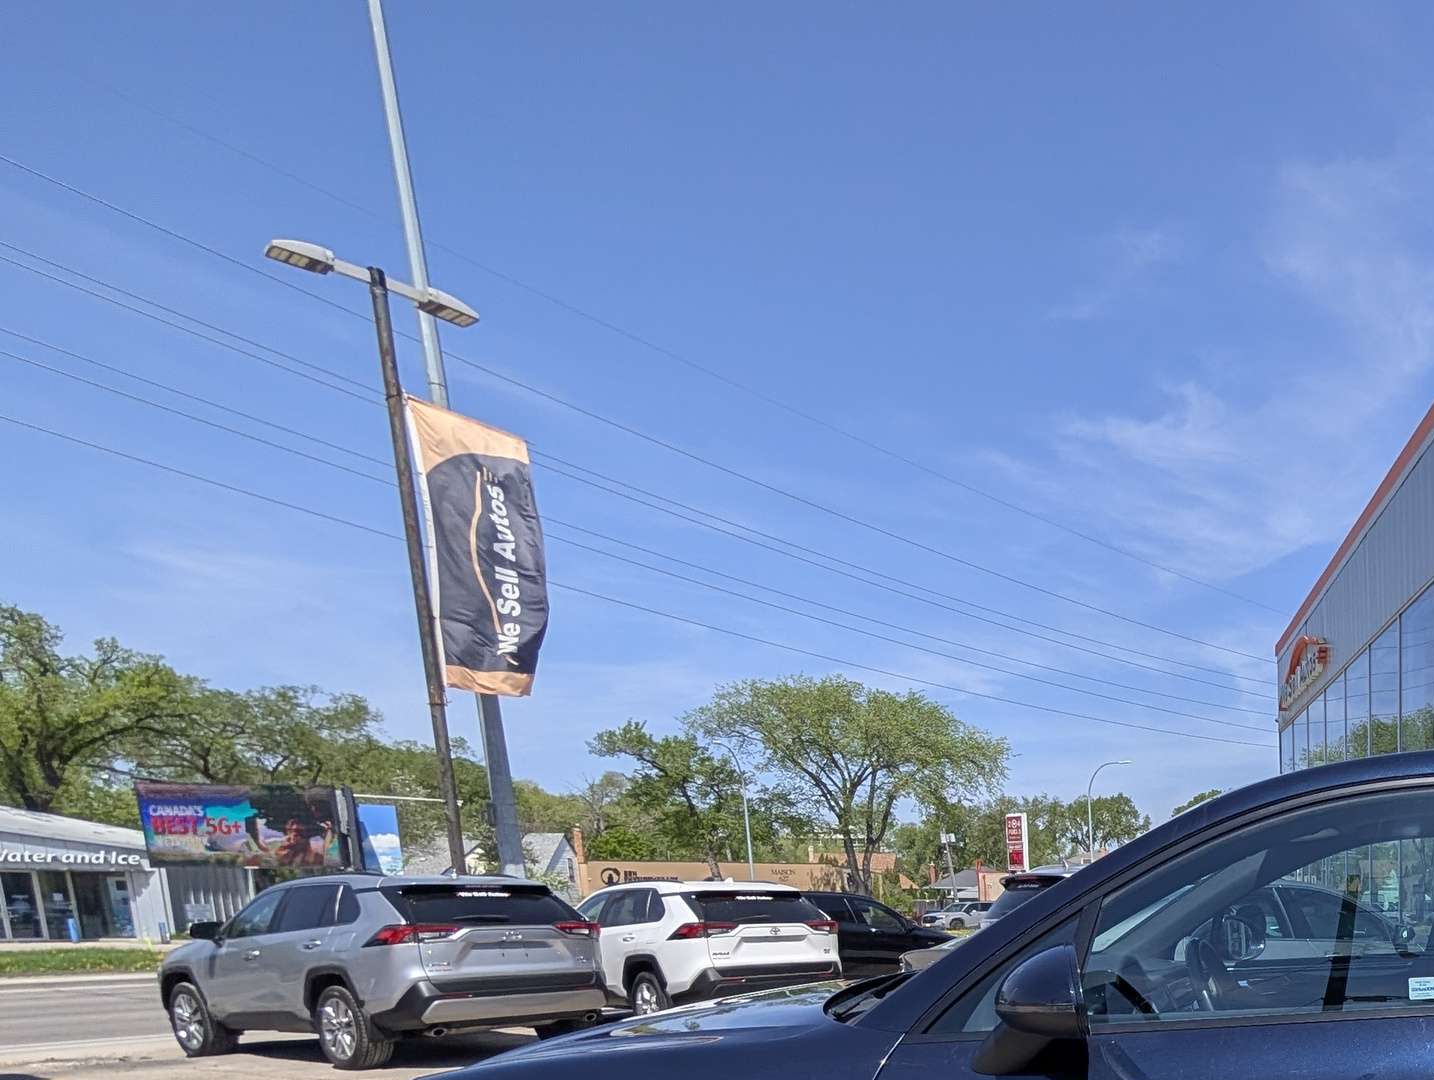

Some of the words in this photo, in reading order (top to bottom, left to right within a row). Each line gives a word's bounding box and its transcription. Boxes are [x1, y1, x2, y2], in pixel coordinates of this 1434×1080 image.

[487, 484, 516, 562] Autos
[494, 565, 521, 617] Sell
[497, 622, 521, 656] We
[205, 816, 241, 836] 5G+
[61, 850, 105, 864] and
[111, 851, 140, 865] Ice
